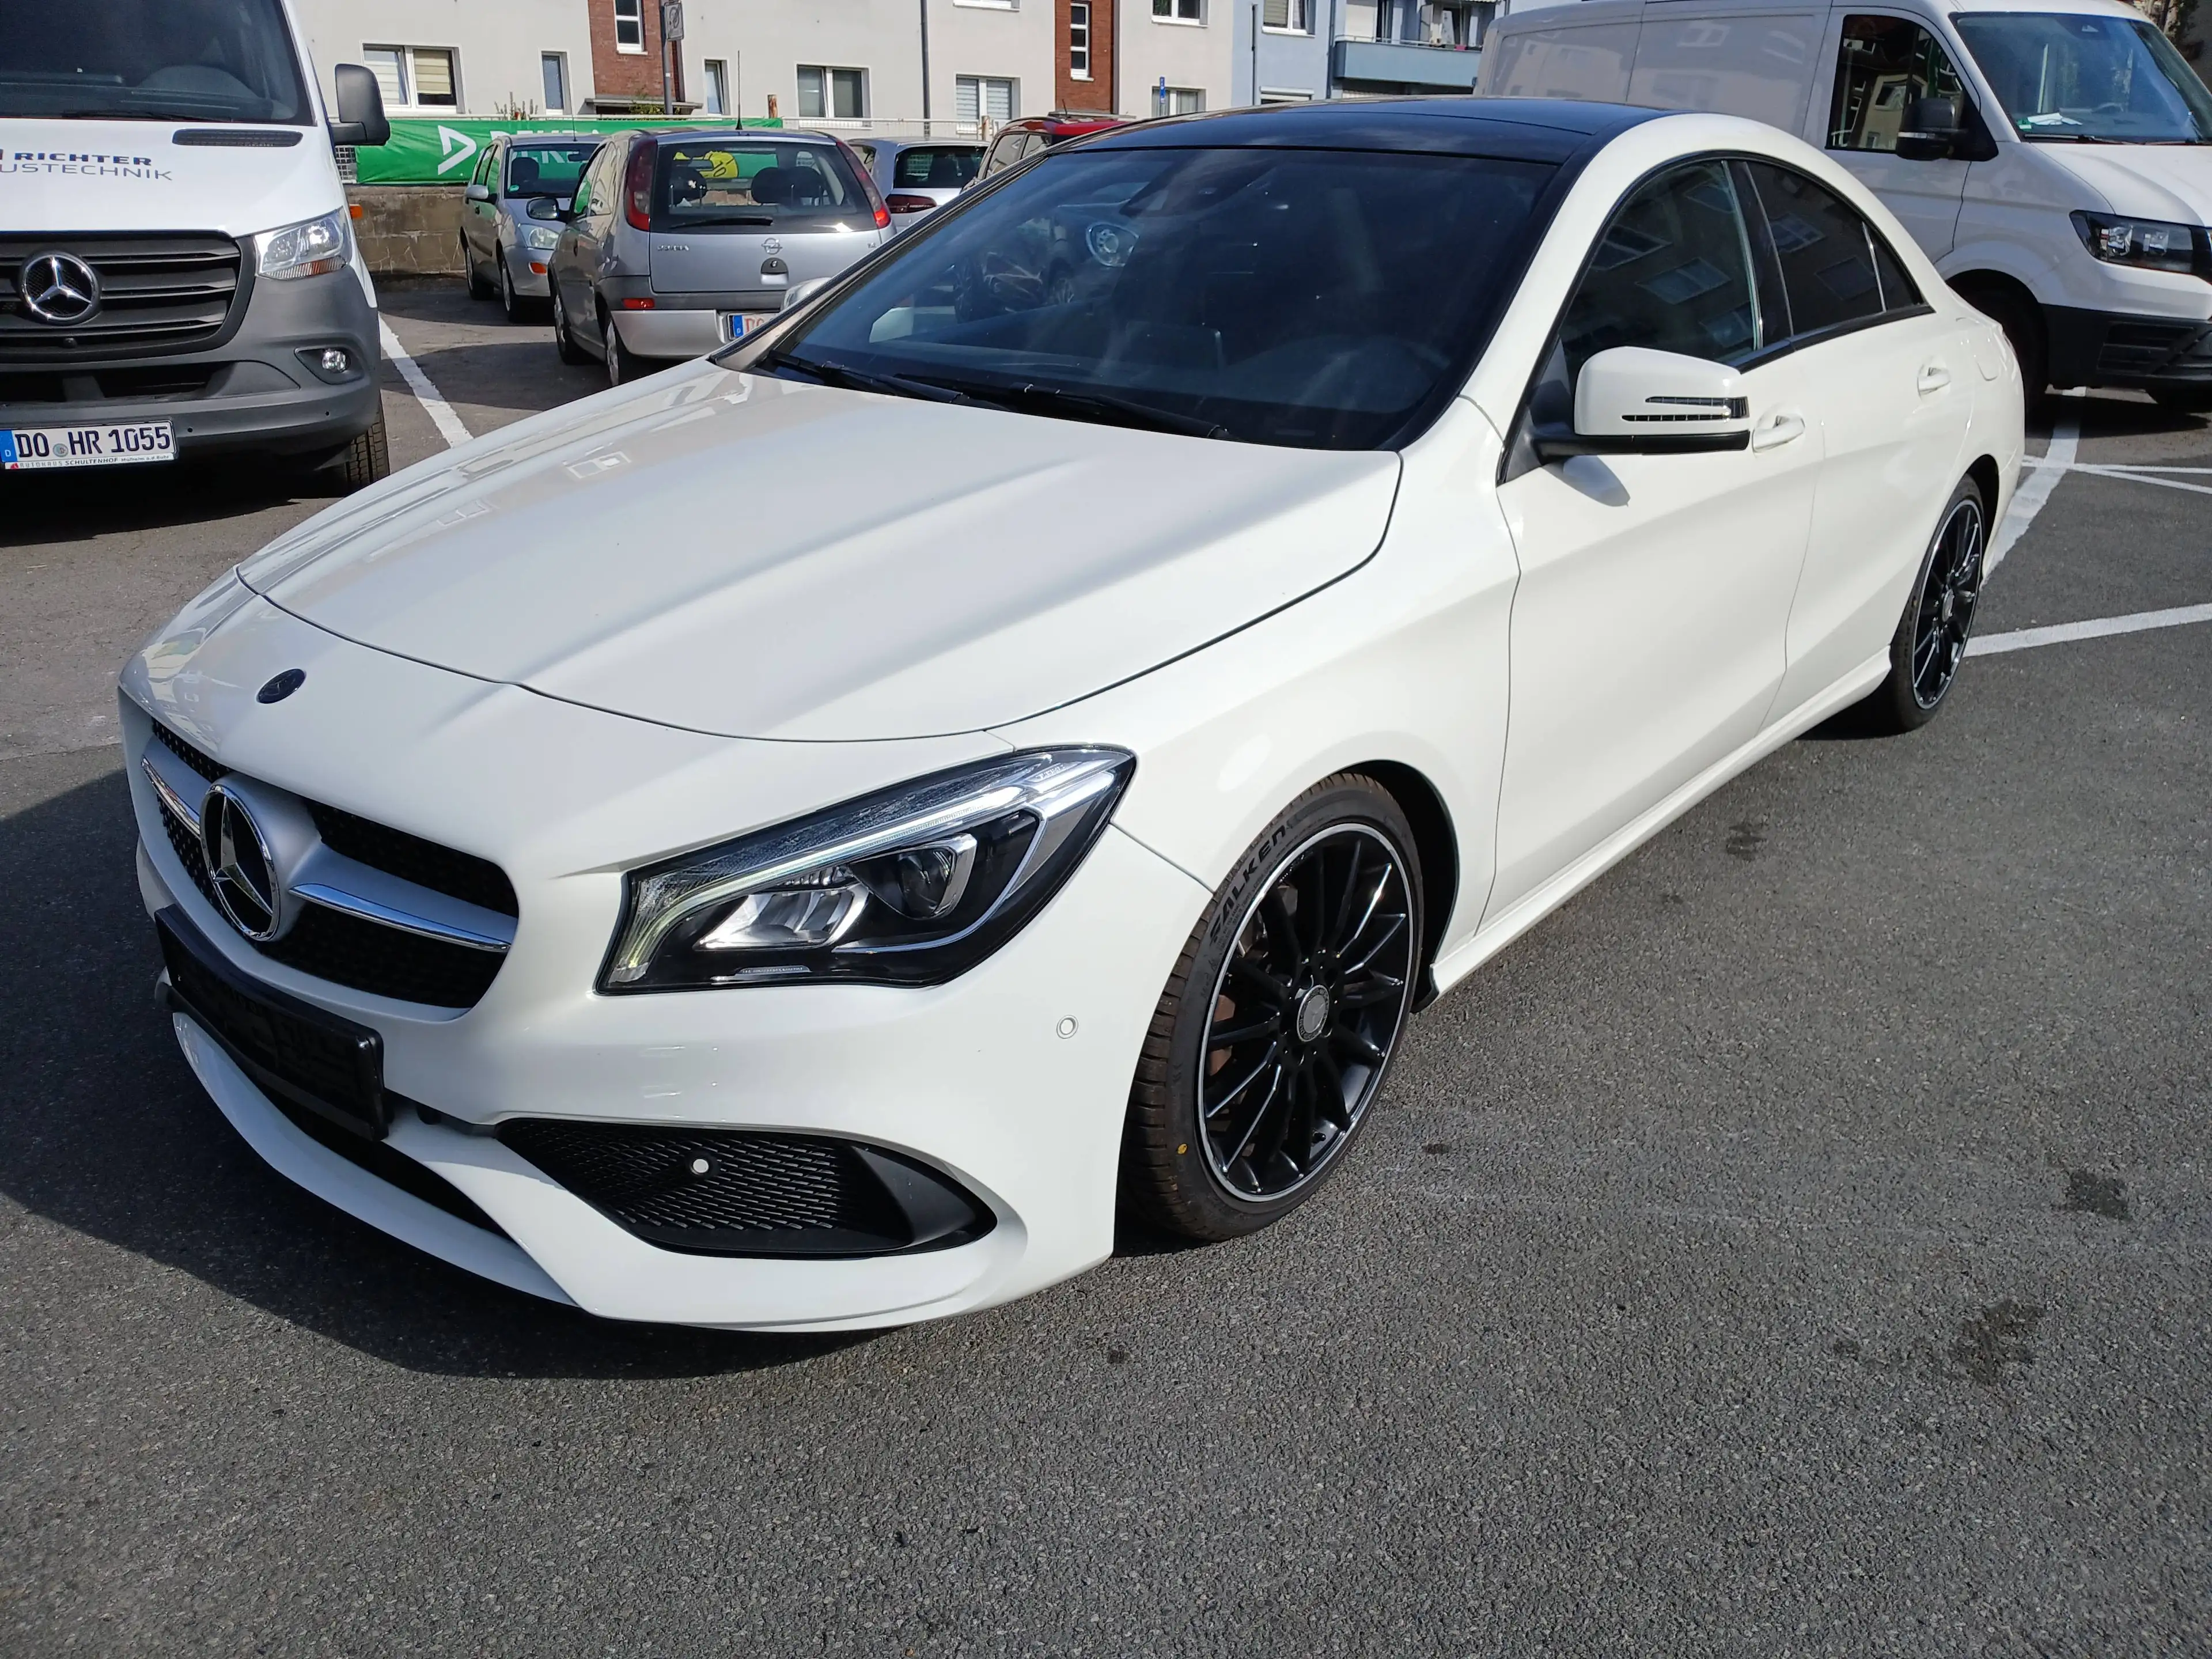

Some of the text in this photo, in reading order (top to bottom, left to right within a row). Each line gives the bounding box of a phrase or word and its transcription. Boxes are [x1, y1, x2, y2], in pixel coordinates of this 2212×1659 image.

[14, 153, 151, 165] RICHTER
[15, 426, 170, 457] DO HR 1055
[65, 457, 119, 466] SCHULTENHOF
